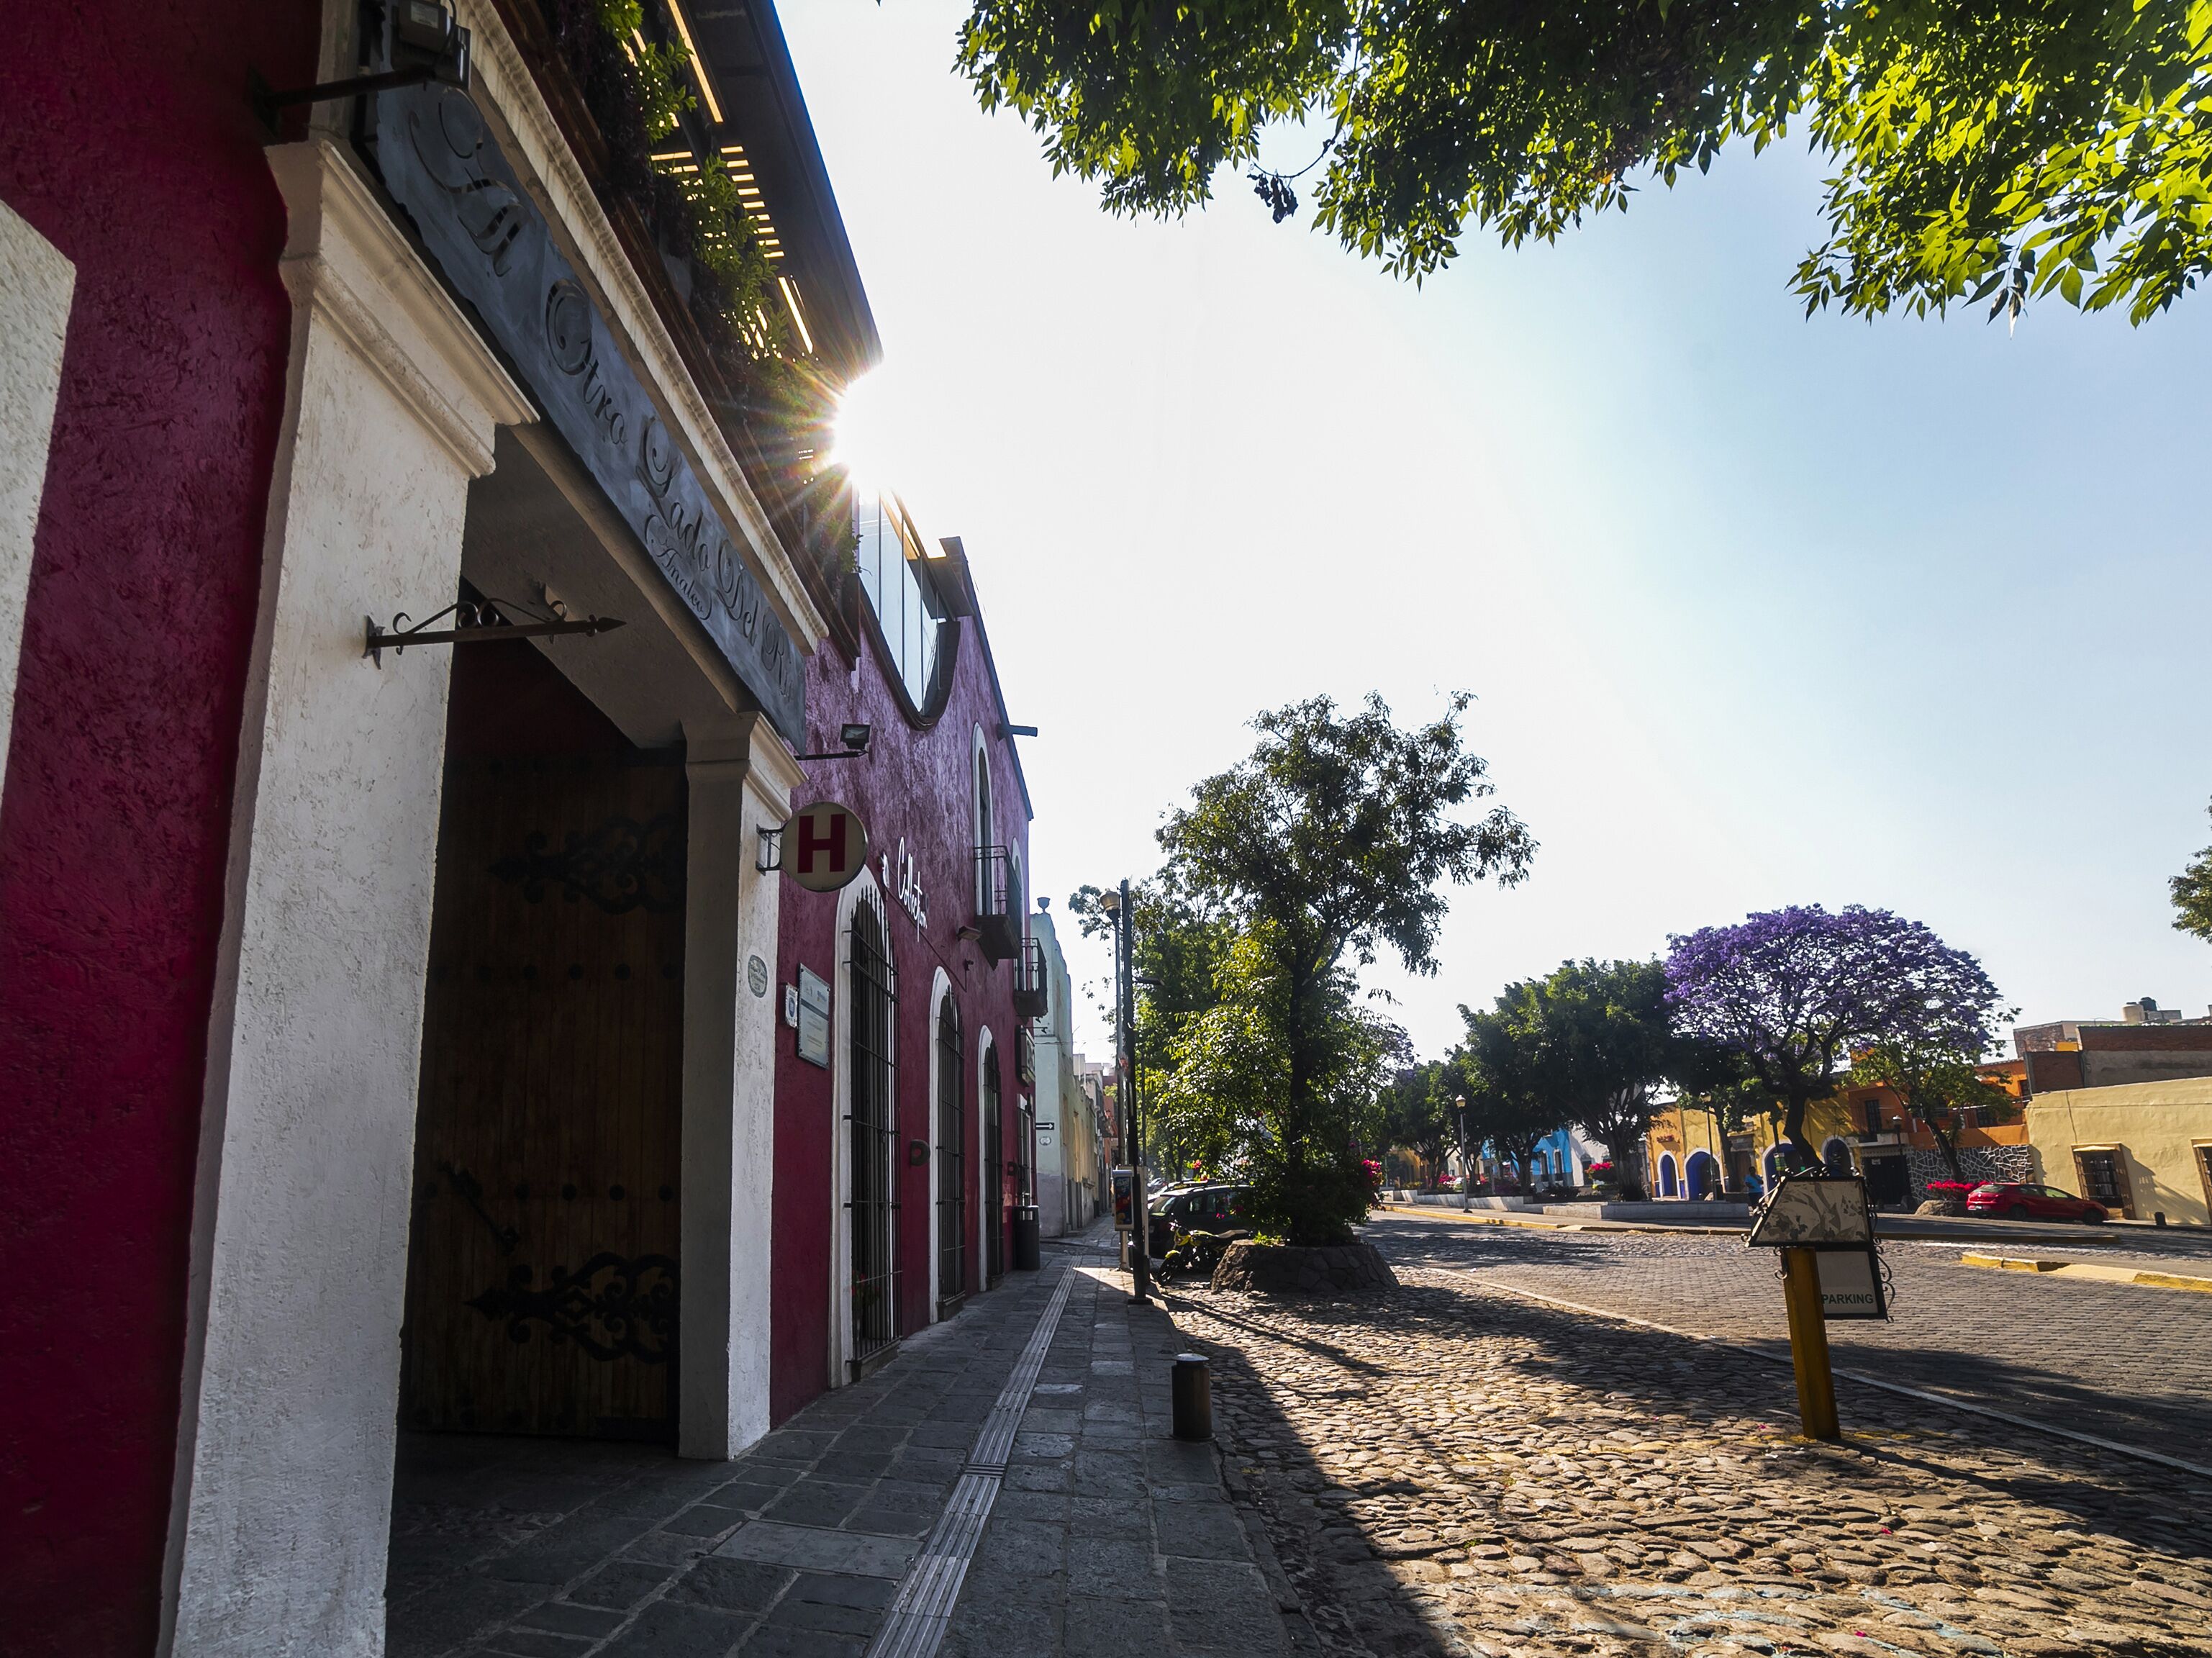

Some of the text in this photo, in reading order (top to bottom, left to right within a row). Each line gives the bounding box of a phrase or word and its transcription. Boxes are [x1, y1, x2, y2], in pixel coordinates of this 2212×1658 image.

[545, 278, 628, 445] Otro
[636, 414, 711, 571] Lado
[715, 539, 759, 646] Del
[797, 813, 846, 874] H
[1821, 1293, 1874, 1305] PARKING
